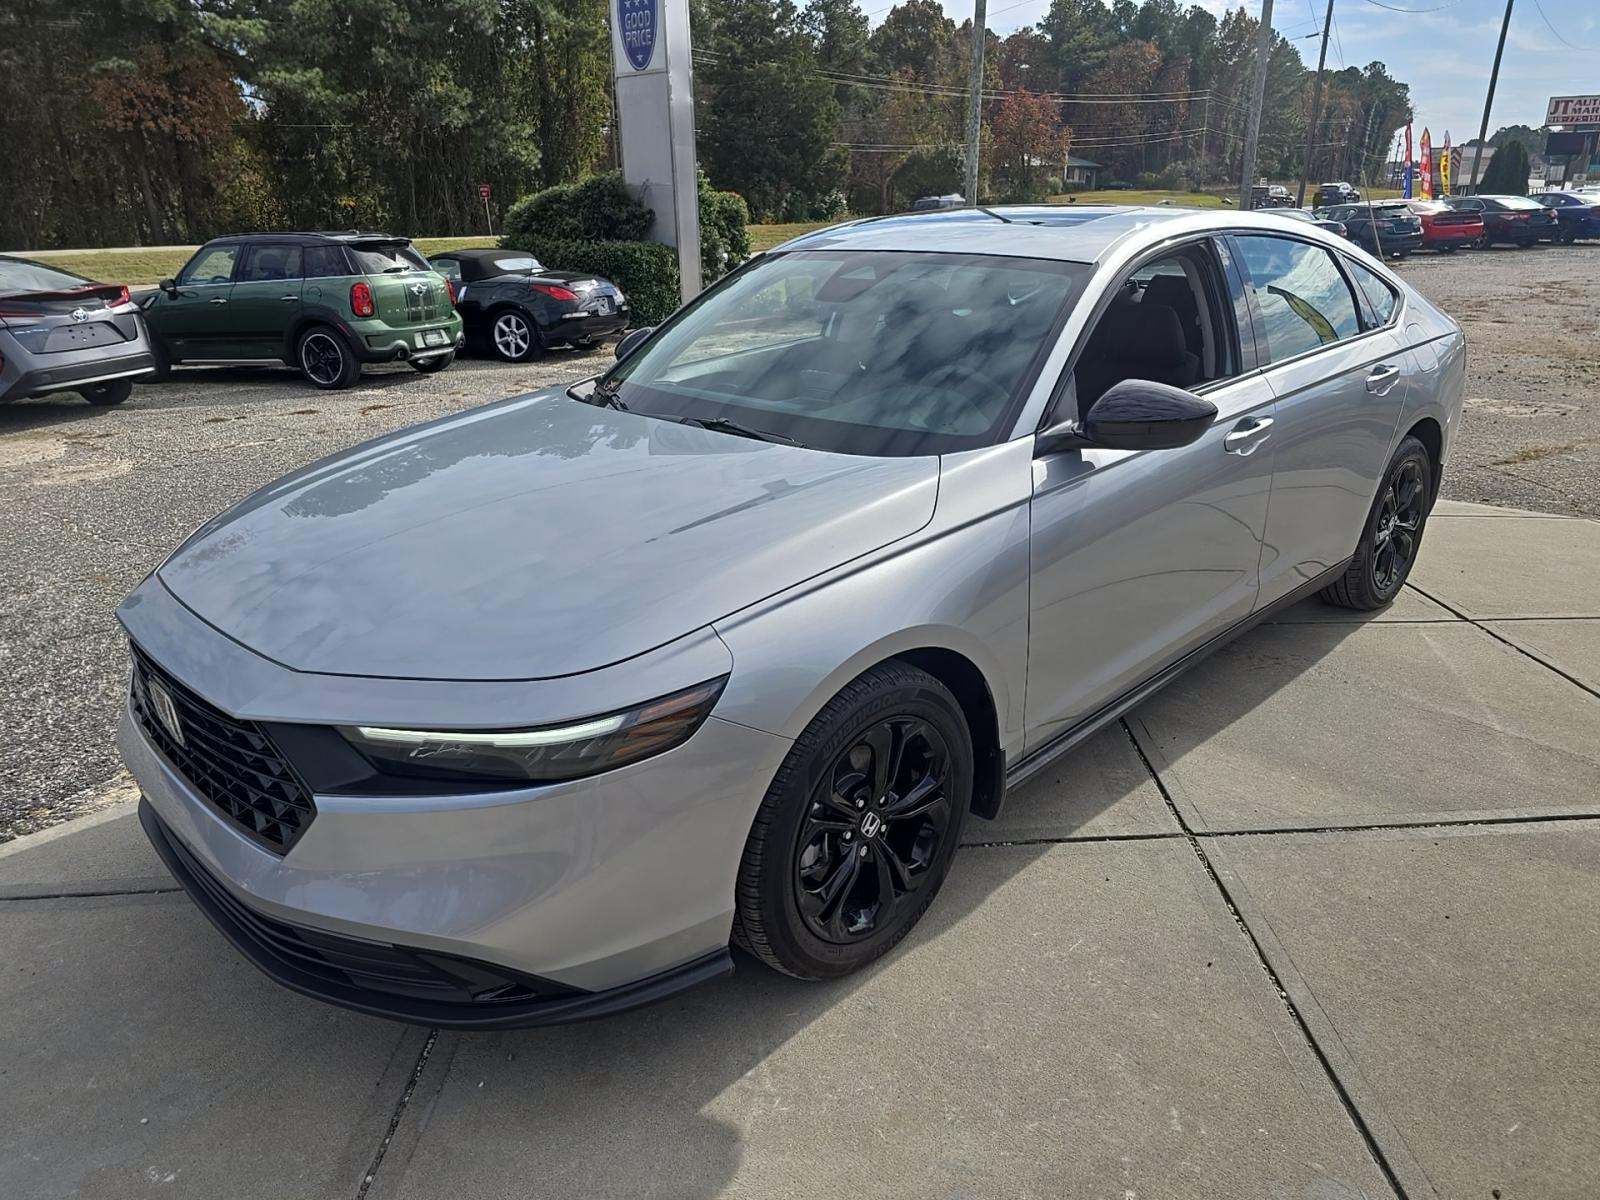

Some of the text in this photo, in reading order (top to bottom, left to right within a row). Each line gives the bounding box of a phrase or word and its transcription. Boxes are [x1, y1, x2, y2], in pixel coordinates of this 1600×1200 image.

[625, 10, 651, 30] GOOD
[625, 29, 651, 47] PRICE
[1550, 99, 1600, 115] JT AUT
